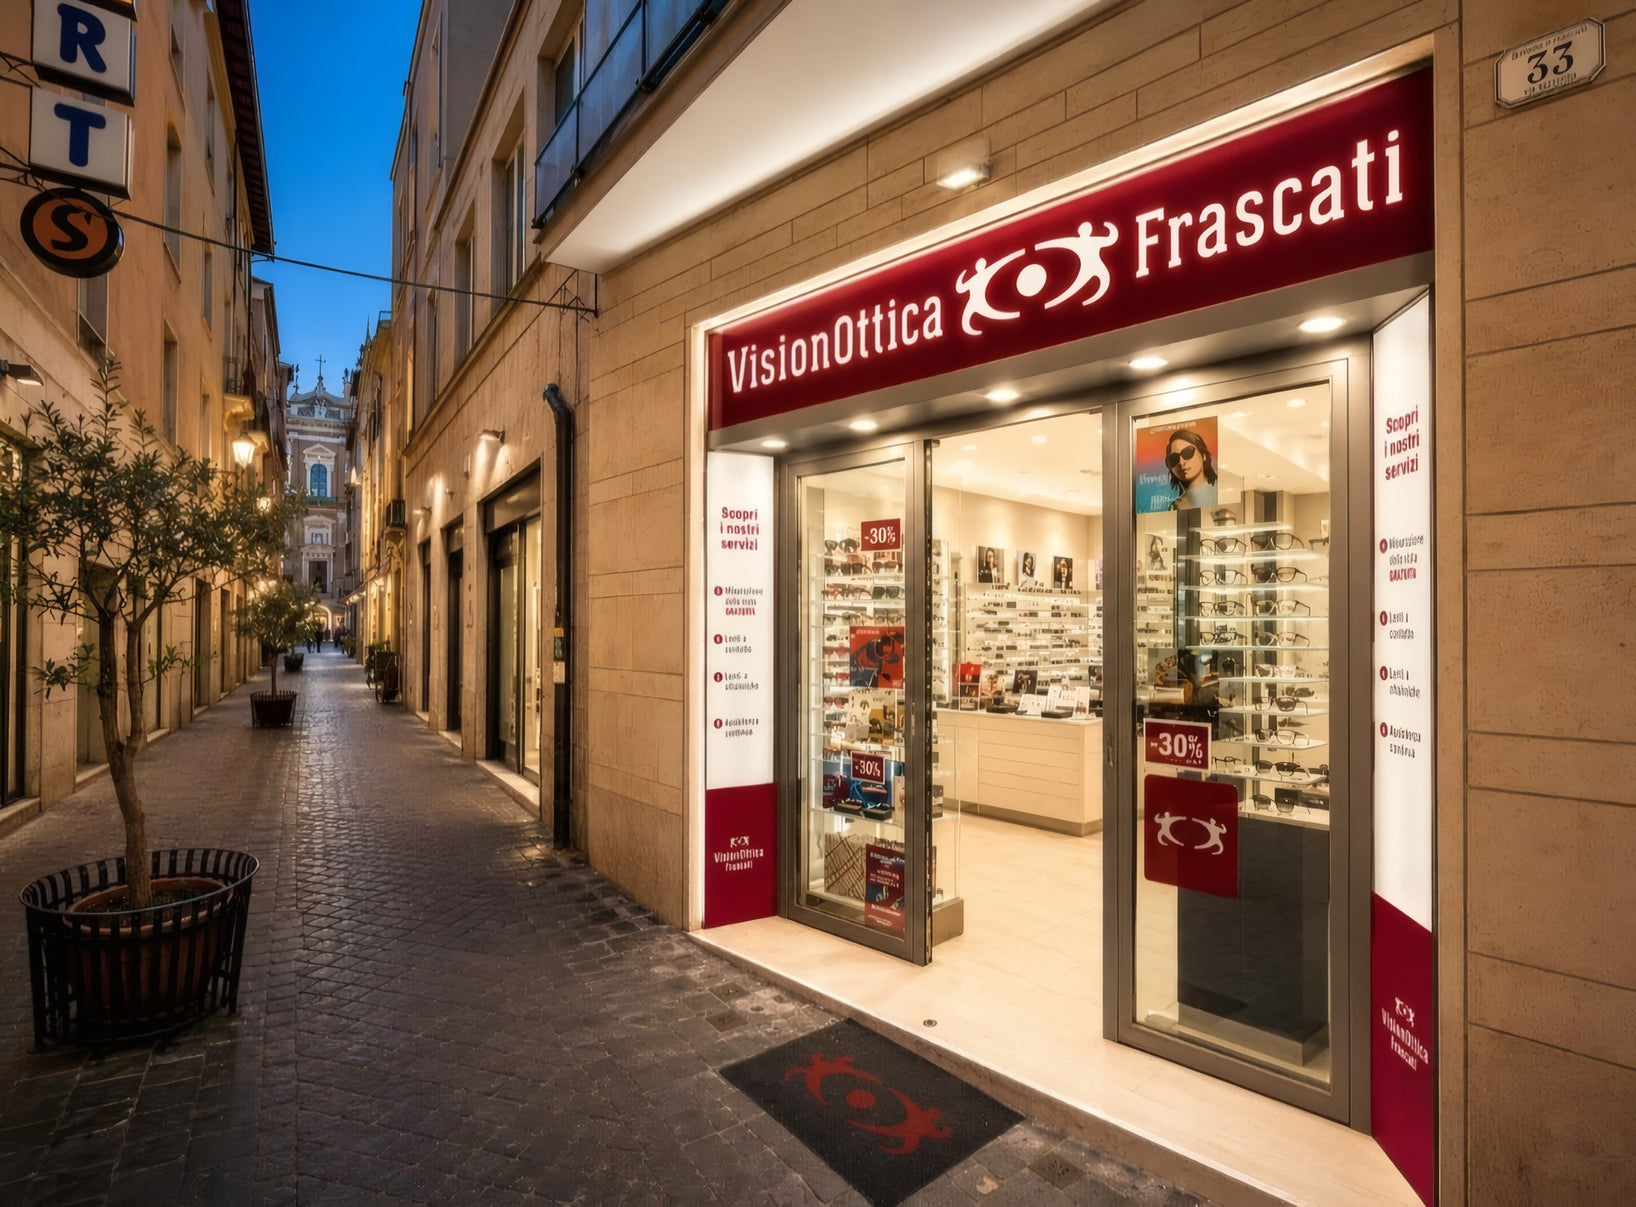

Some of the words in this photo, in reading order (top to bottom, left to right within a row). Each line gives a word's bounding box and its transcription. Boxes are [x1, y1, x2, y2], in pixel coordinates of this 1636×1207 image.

[57, 3, 107, 73] R
[1527, 40, 1574, 84] 33
[53, 102, 107, 168] T
[727, 295, 943, 394] VisionOttica
[1135, 129, 1403, 279] Frascati
[1386, 404, 1419, 435] Scopri
[1384, 440, 1388, 459] i
[1390, 428, 1420, 457] nostri
[1385, 452, 1419, 481] servizi
[719, 521, 724, 535] i
[726, 523, 760, 536] nostri
[721, 506, 758, 522] Scopri
[721, 537, 758, 551] servizi
[864, 526, 896, 546] -30%
[1150, 732, 1203, 759] -30%
[854, 759, 881, 778] -30%
